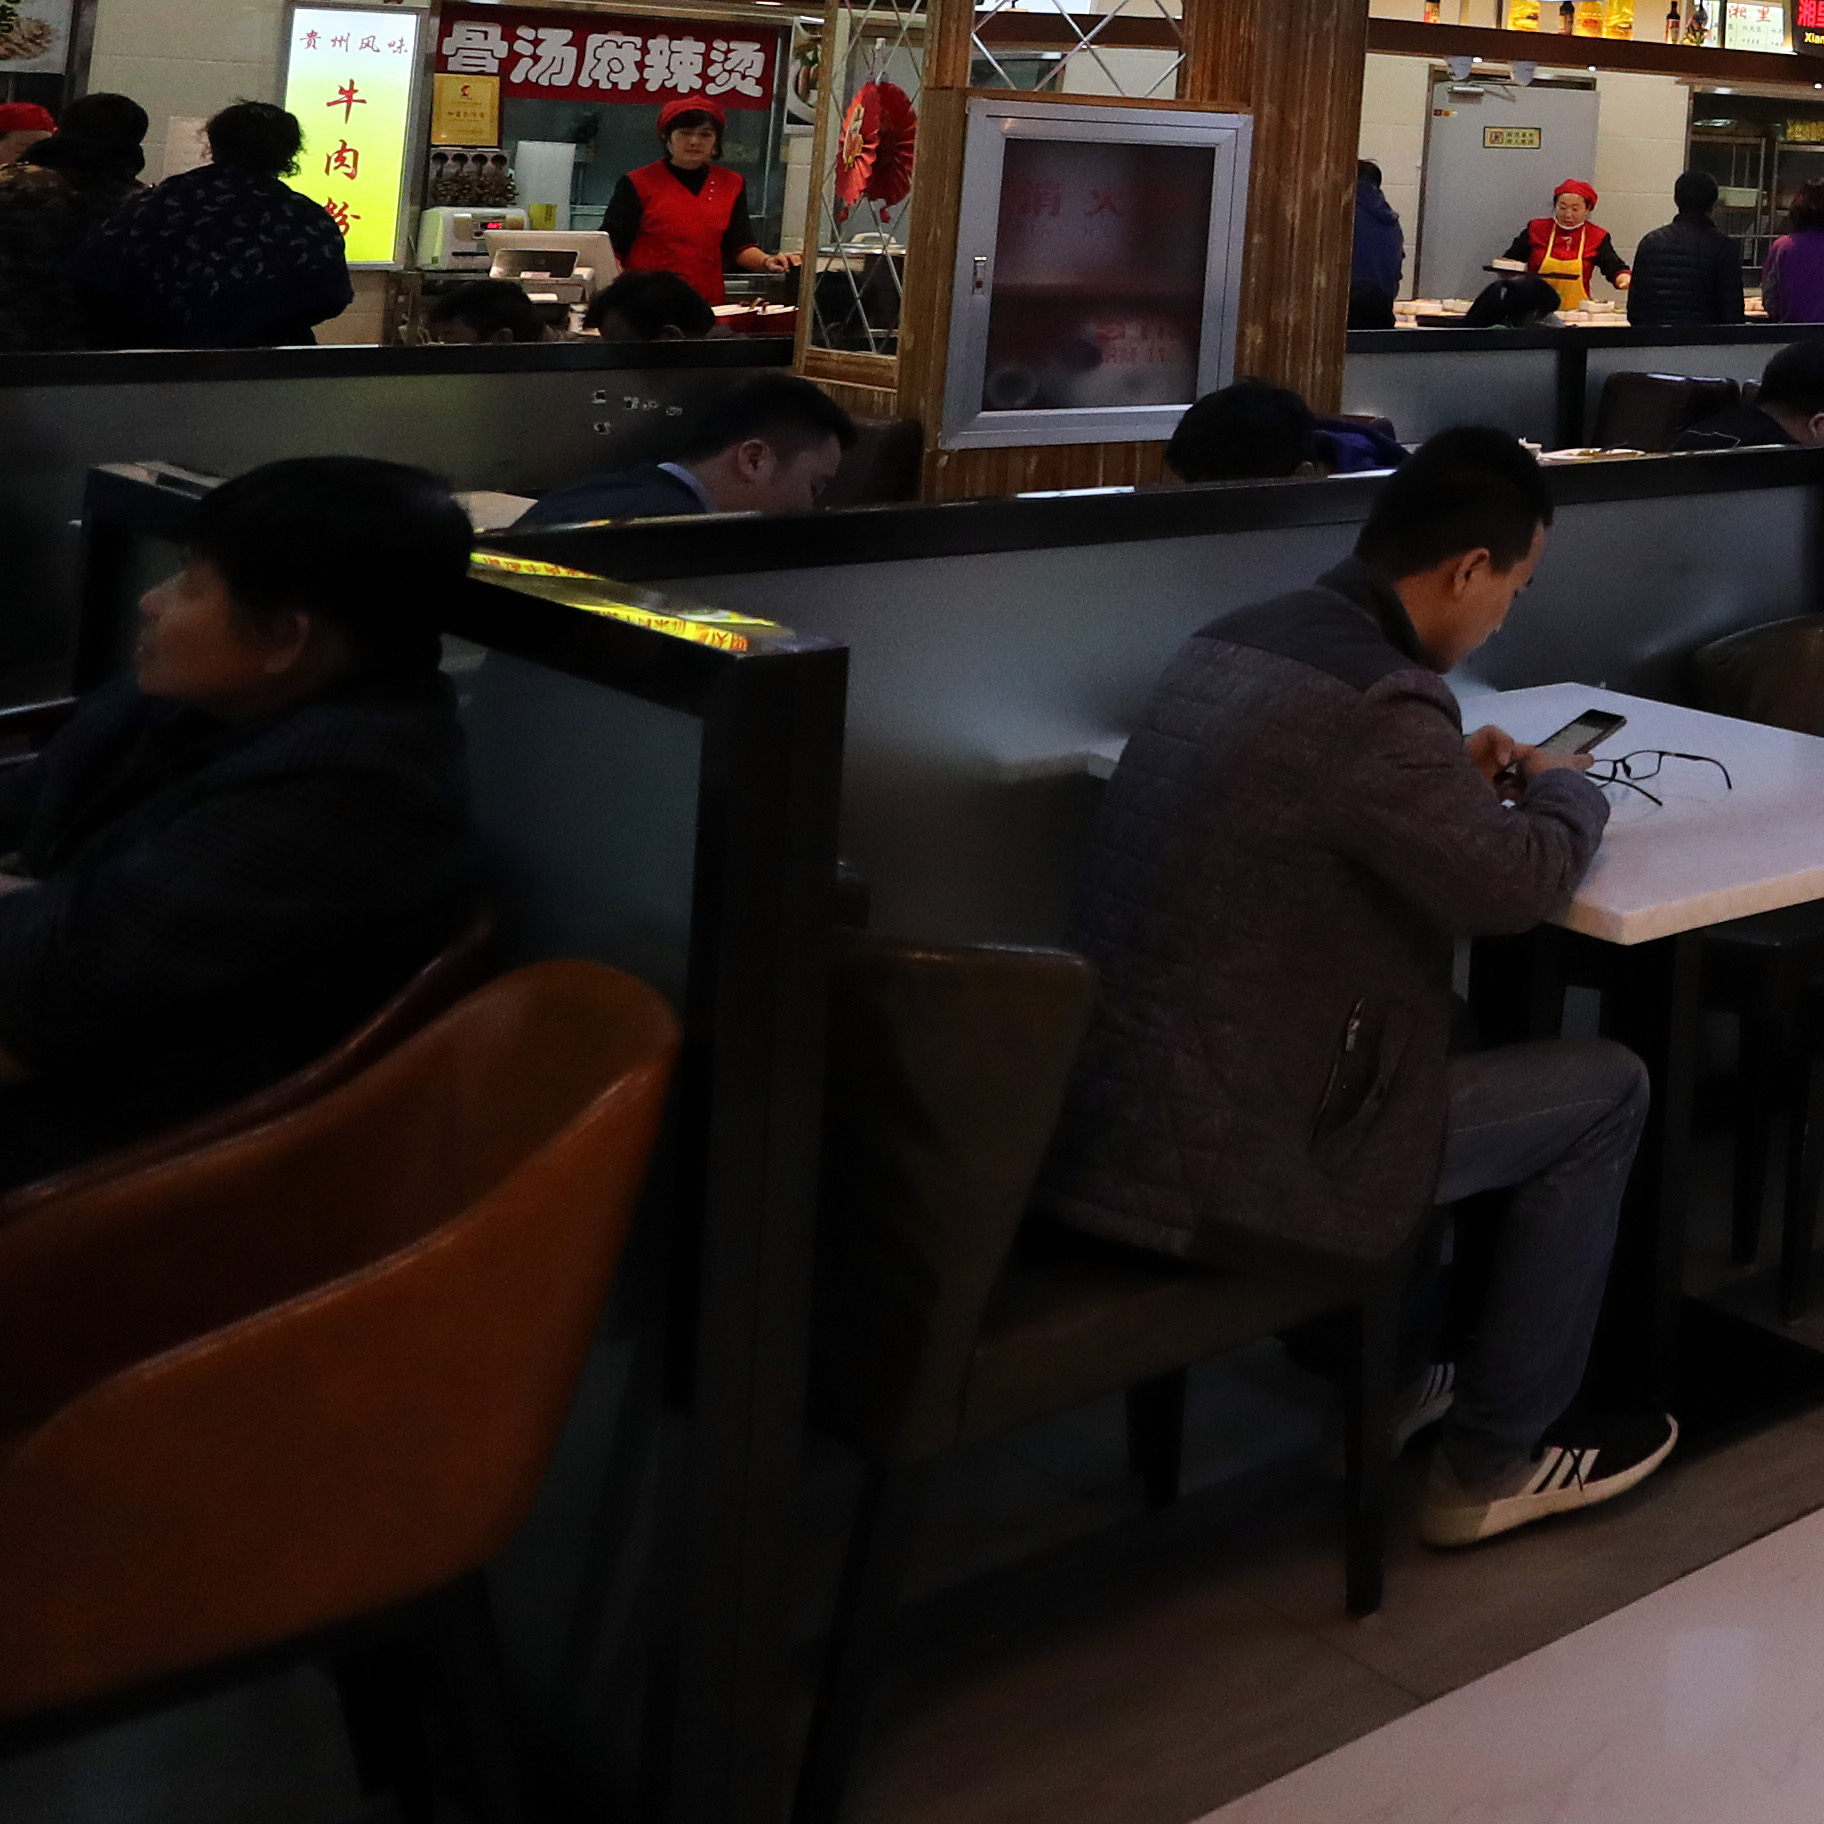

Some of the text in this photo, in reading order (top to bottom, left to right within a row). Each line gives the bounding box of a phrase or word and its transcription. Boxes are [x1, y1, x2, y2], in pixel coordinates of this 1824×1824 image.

[442, 20, 766, 97] 骨汤麻辣烫
[324, 78, 367, 238] 牛肉粉
